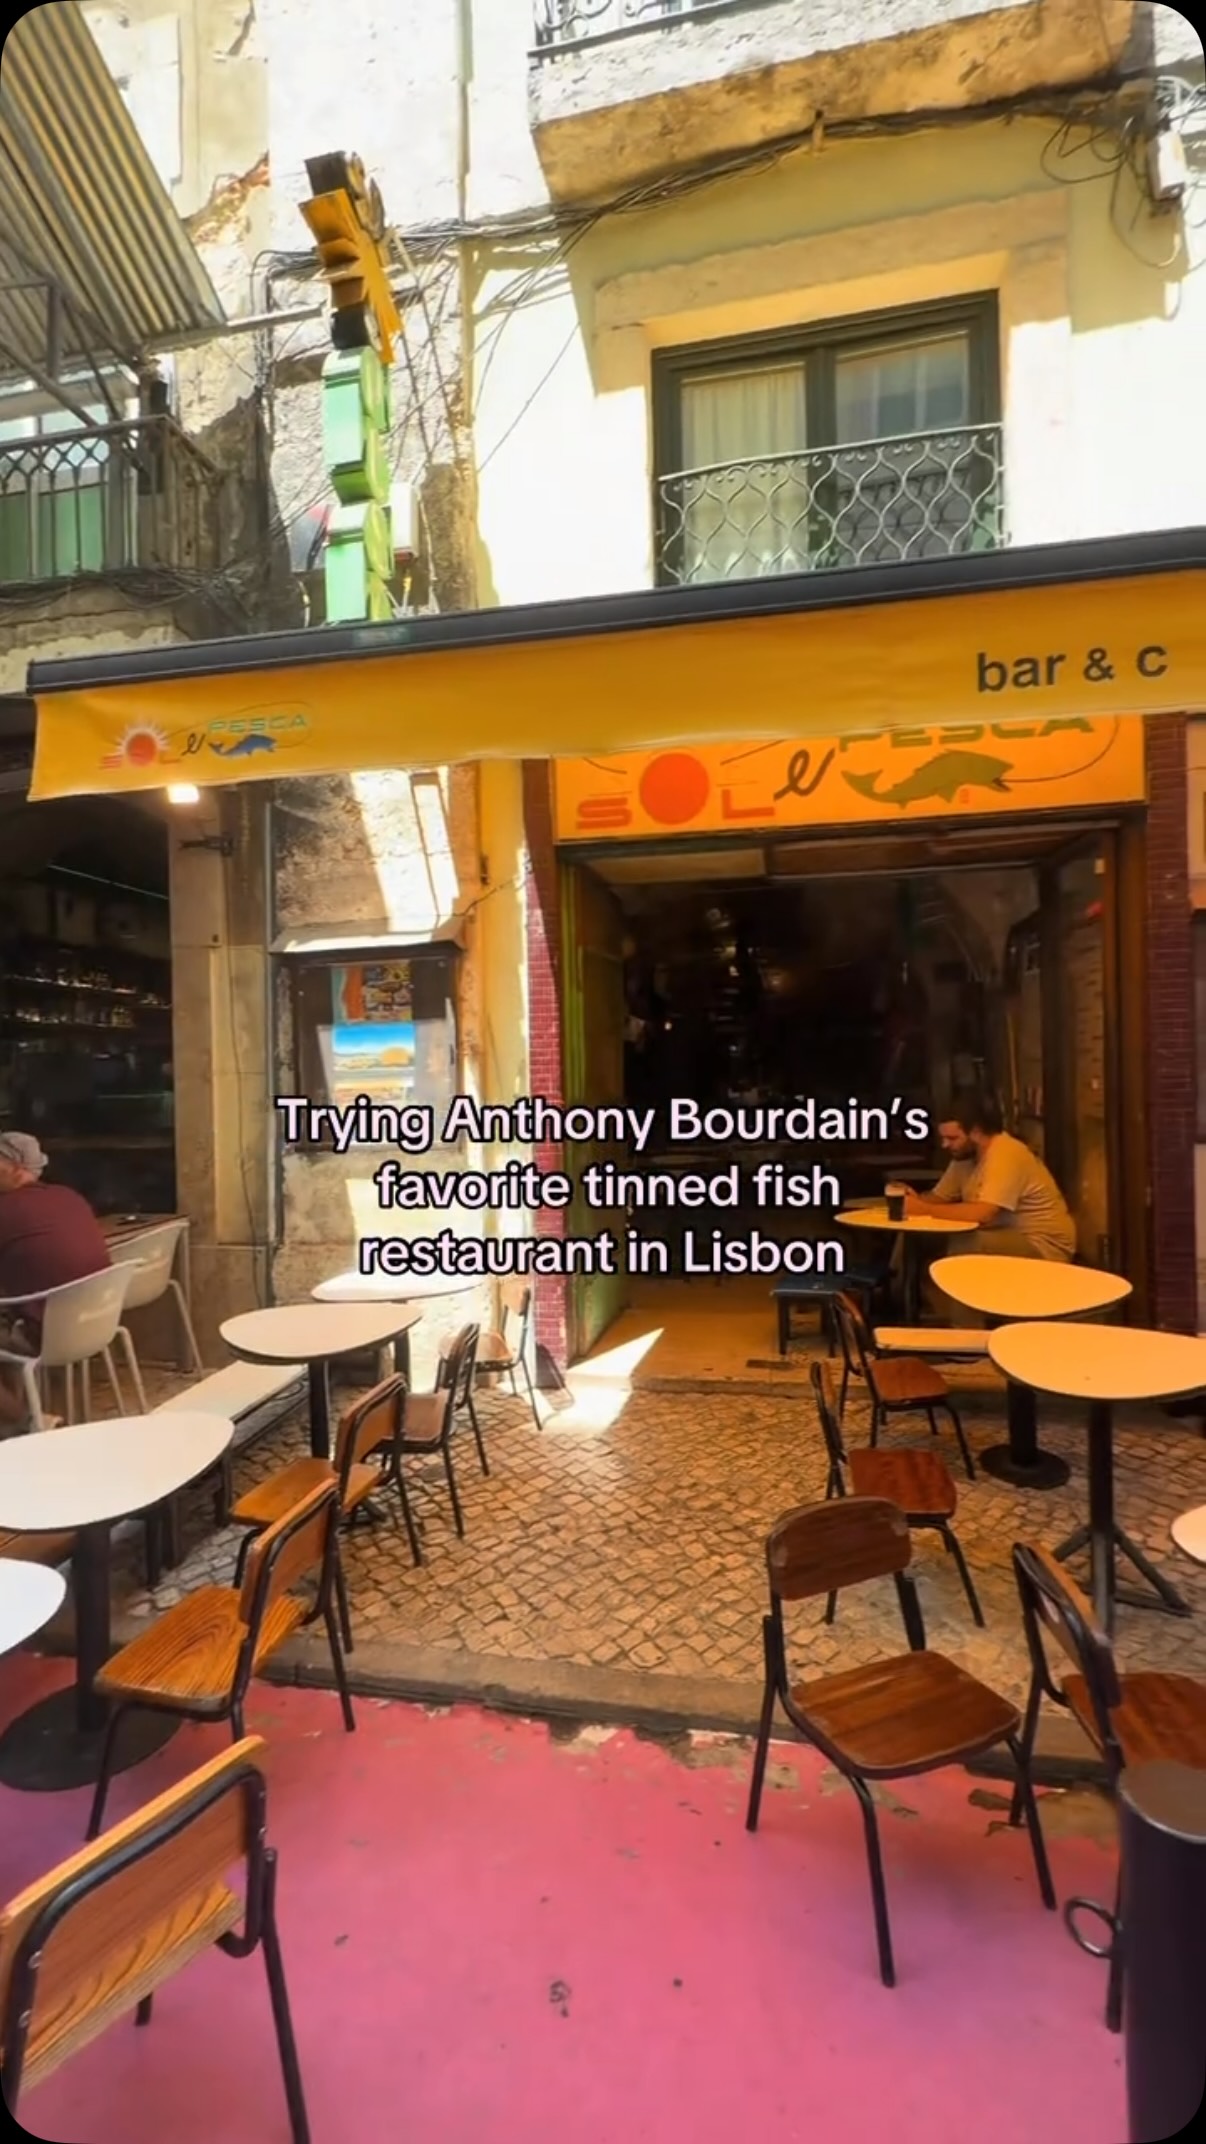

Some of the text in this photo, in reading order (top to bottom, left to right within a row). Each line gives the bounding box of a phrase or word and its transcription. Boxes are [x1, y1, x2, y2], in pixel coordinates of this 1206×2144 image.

[977, 645, 1168, 693] bar & c
[207, 713, 308, 734] PESCA
[576, 752, 776, 830] SOL
